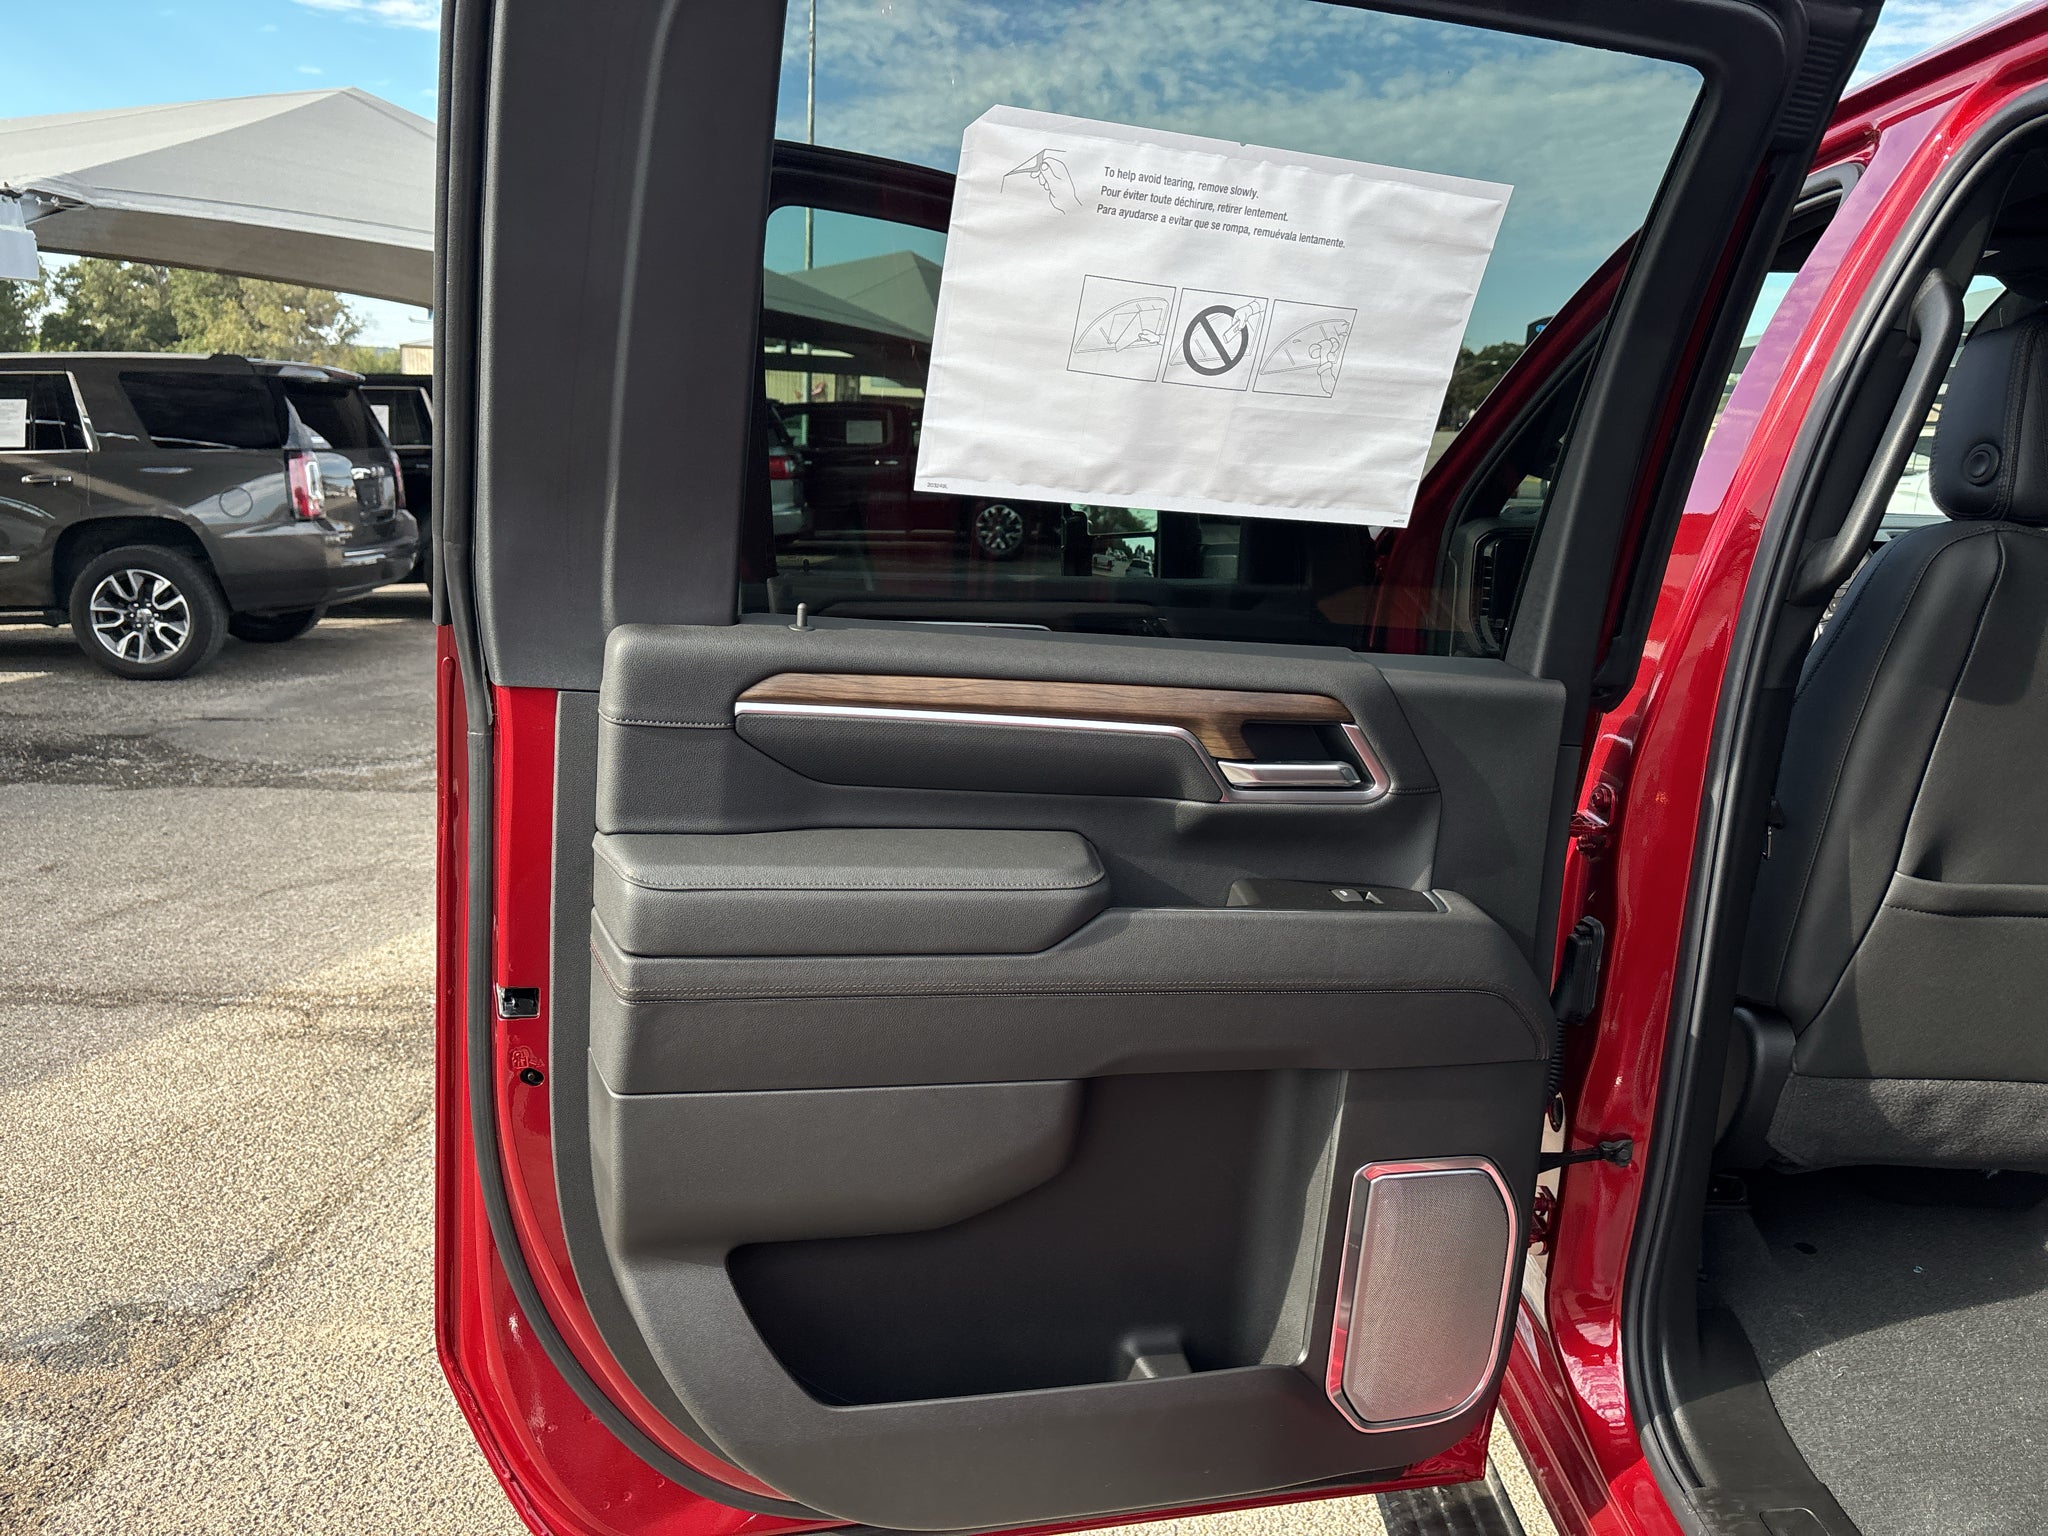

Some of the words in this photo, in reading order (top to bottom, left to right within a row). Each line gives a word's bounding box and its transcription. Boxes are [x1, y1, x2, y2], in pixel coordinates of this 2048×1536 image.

[1105, 166, 1115, 178] To
[1117, 169, 1137, 183] help
[1138, 172, 1161, 185] avoid
[1163, 175, 1195, 191] tearing,
[1198, 182, 1229, 194] remove
[1230, 186, 1259, 200] slowly.
[1100, 186, 1120, 198] Pour
[1123, 188, 1148, 201] éviter
[1150, 192, 1172, 205] toute
[1174, 196, 1215, 213] déchirure,
[1217, 203, 1243, 215] retirer
[1244, 206, 1289, 222] lentement.
[1097, 204, 1117, 216] Para
[1118, 208, 1159, 222] ayudarse
[1160, 215, 1166, 223] a
[1168, 215, 1194, 227] evitar
[1194, 219, 1209, 230] que
[1210, 221, 1221, 230] se
[1222, 223, 1251, 237] rompa,
[1253, 226, 1298, 242] remuévala
[1298, 233, 1346, 249] lentamente.
